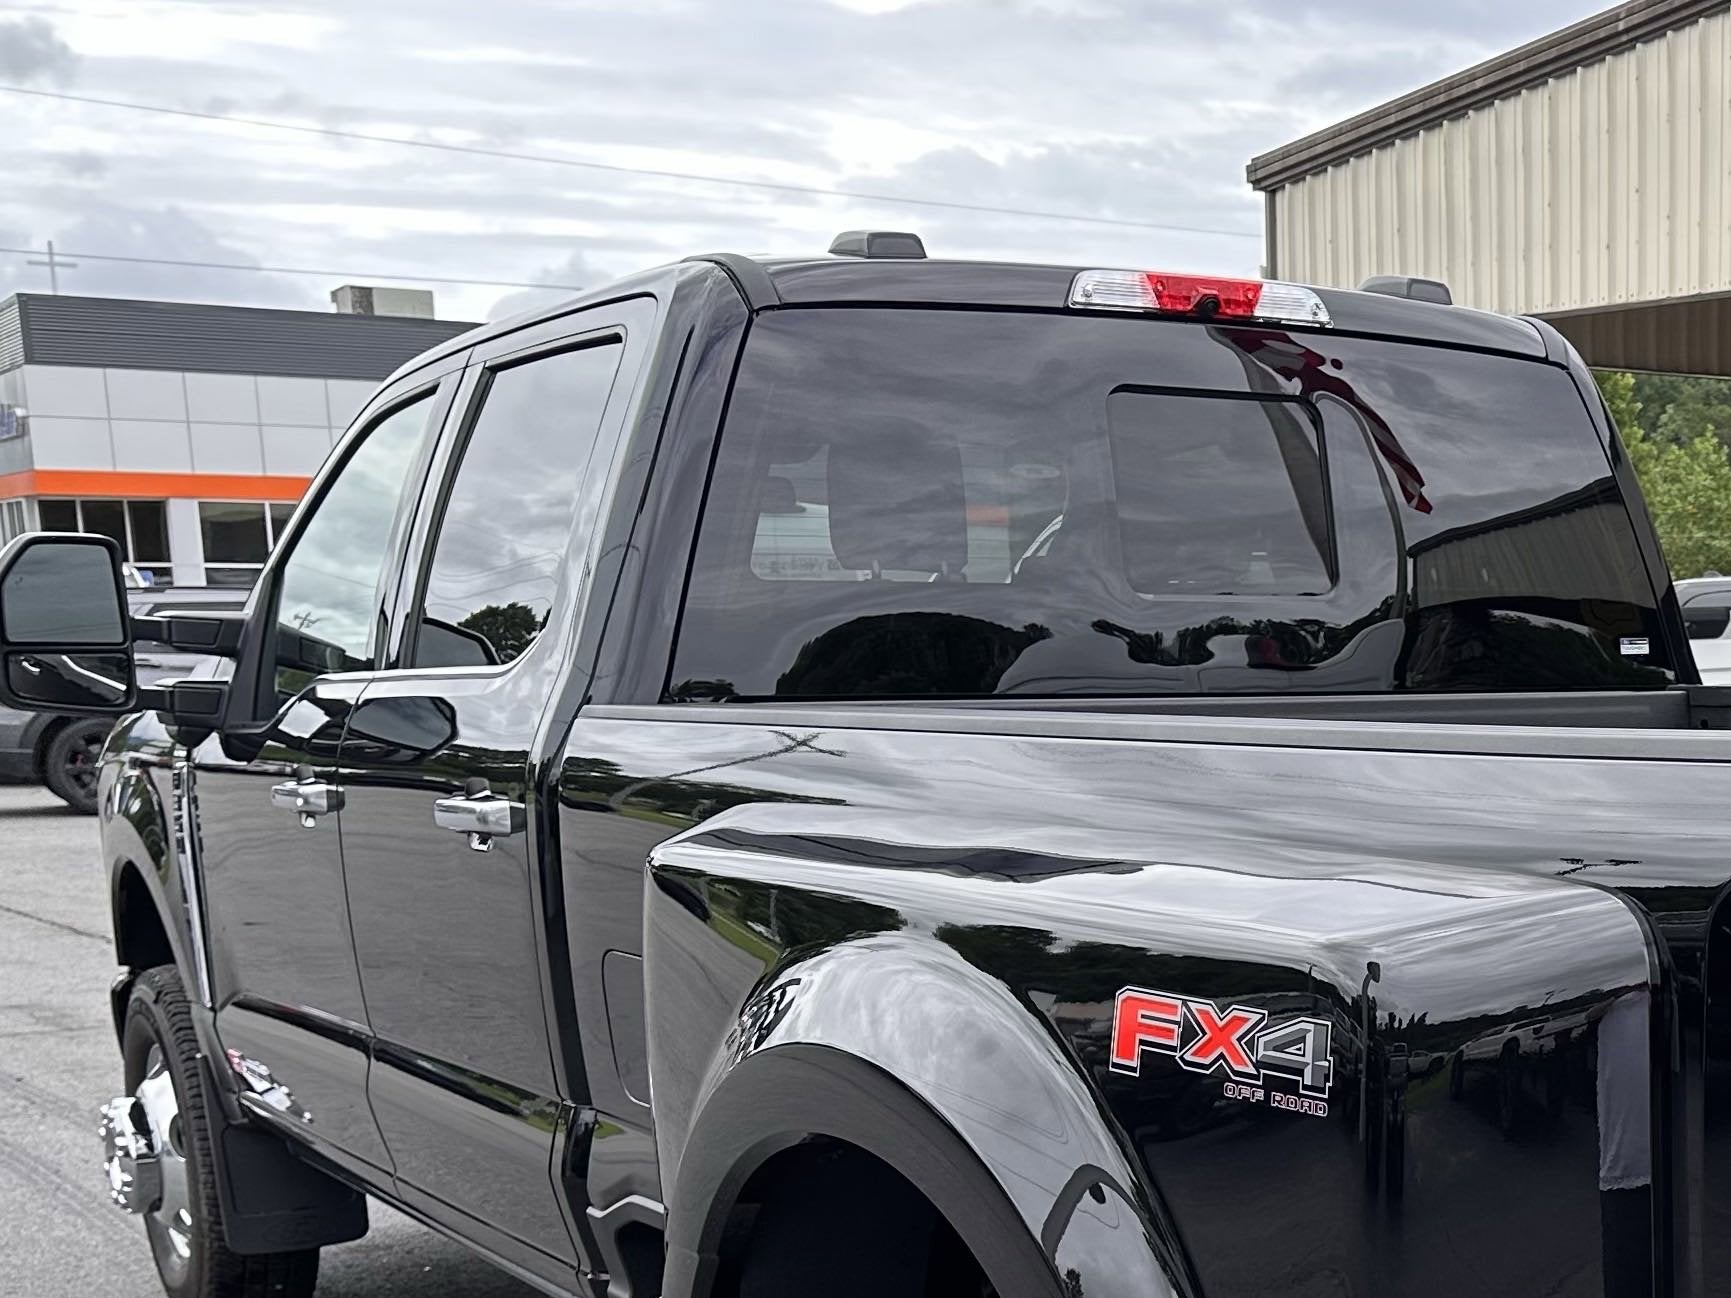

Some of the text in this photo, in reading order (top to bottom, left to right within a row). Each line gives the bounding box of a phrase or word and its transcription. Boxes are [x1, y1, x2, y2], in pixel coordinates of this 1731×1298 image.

[1109, 985, 1333, 1098] FX4
[1223, 1082, 1329, 1118] OFF ROAD
